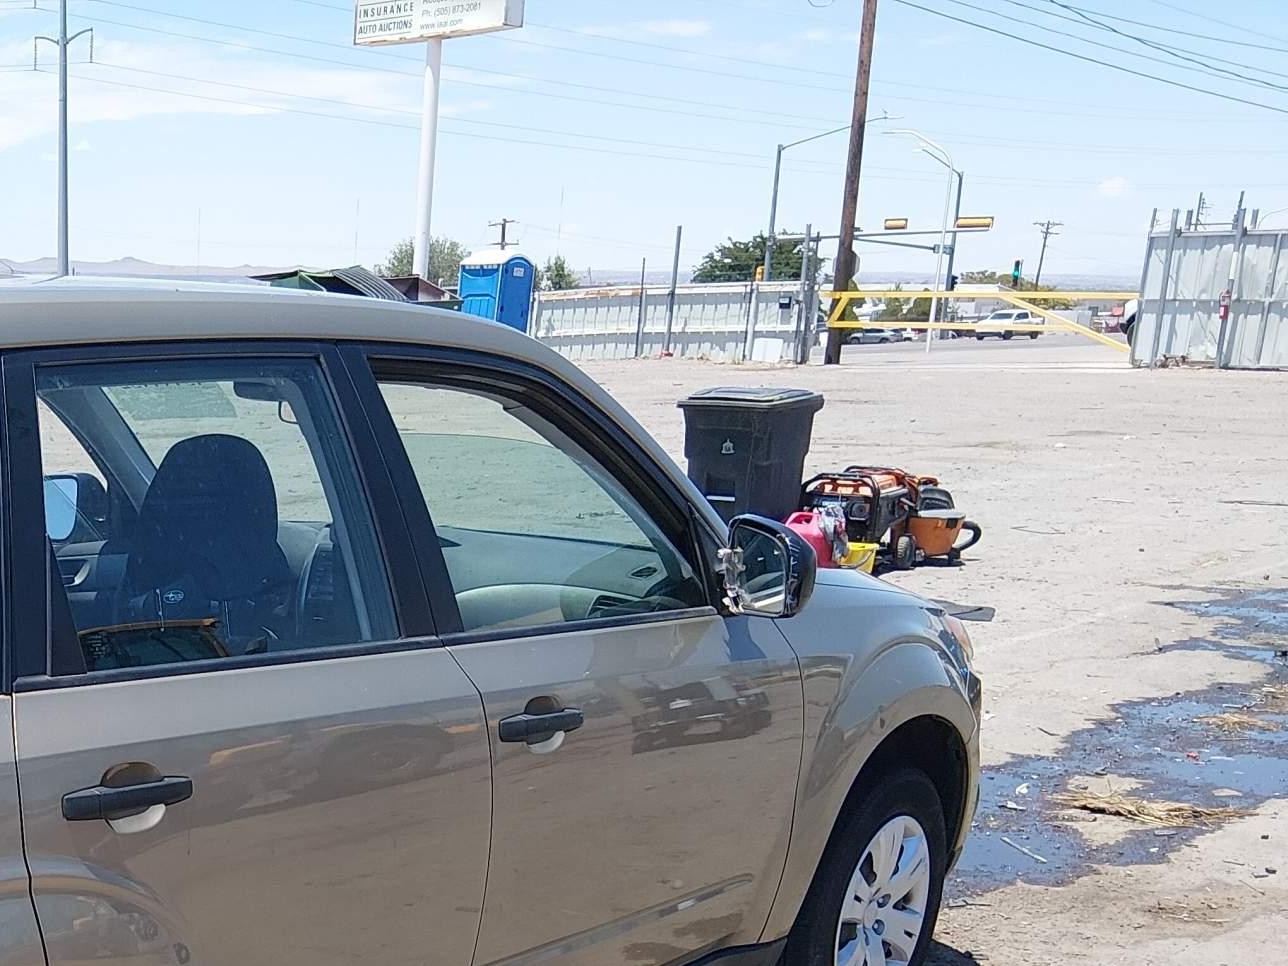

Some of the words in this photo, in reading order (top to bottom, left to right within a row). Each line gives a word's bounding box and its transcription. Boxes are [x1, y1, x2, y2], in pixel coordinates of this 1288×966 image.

[359, 2, 414, 18] INSURANCE
[358, 23, 377, 35] AUTO
[378, 19, 413, 32] AUCTIONS
